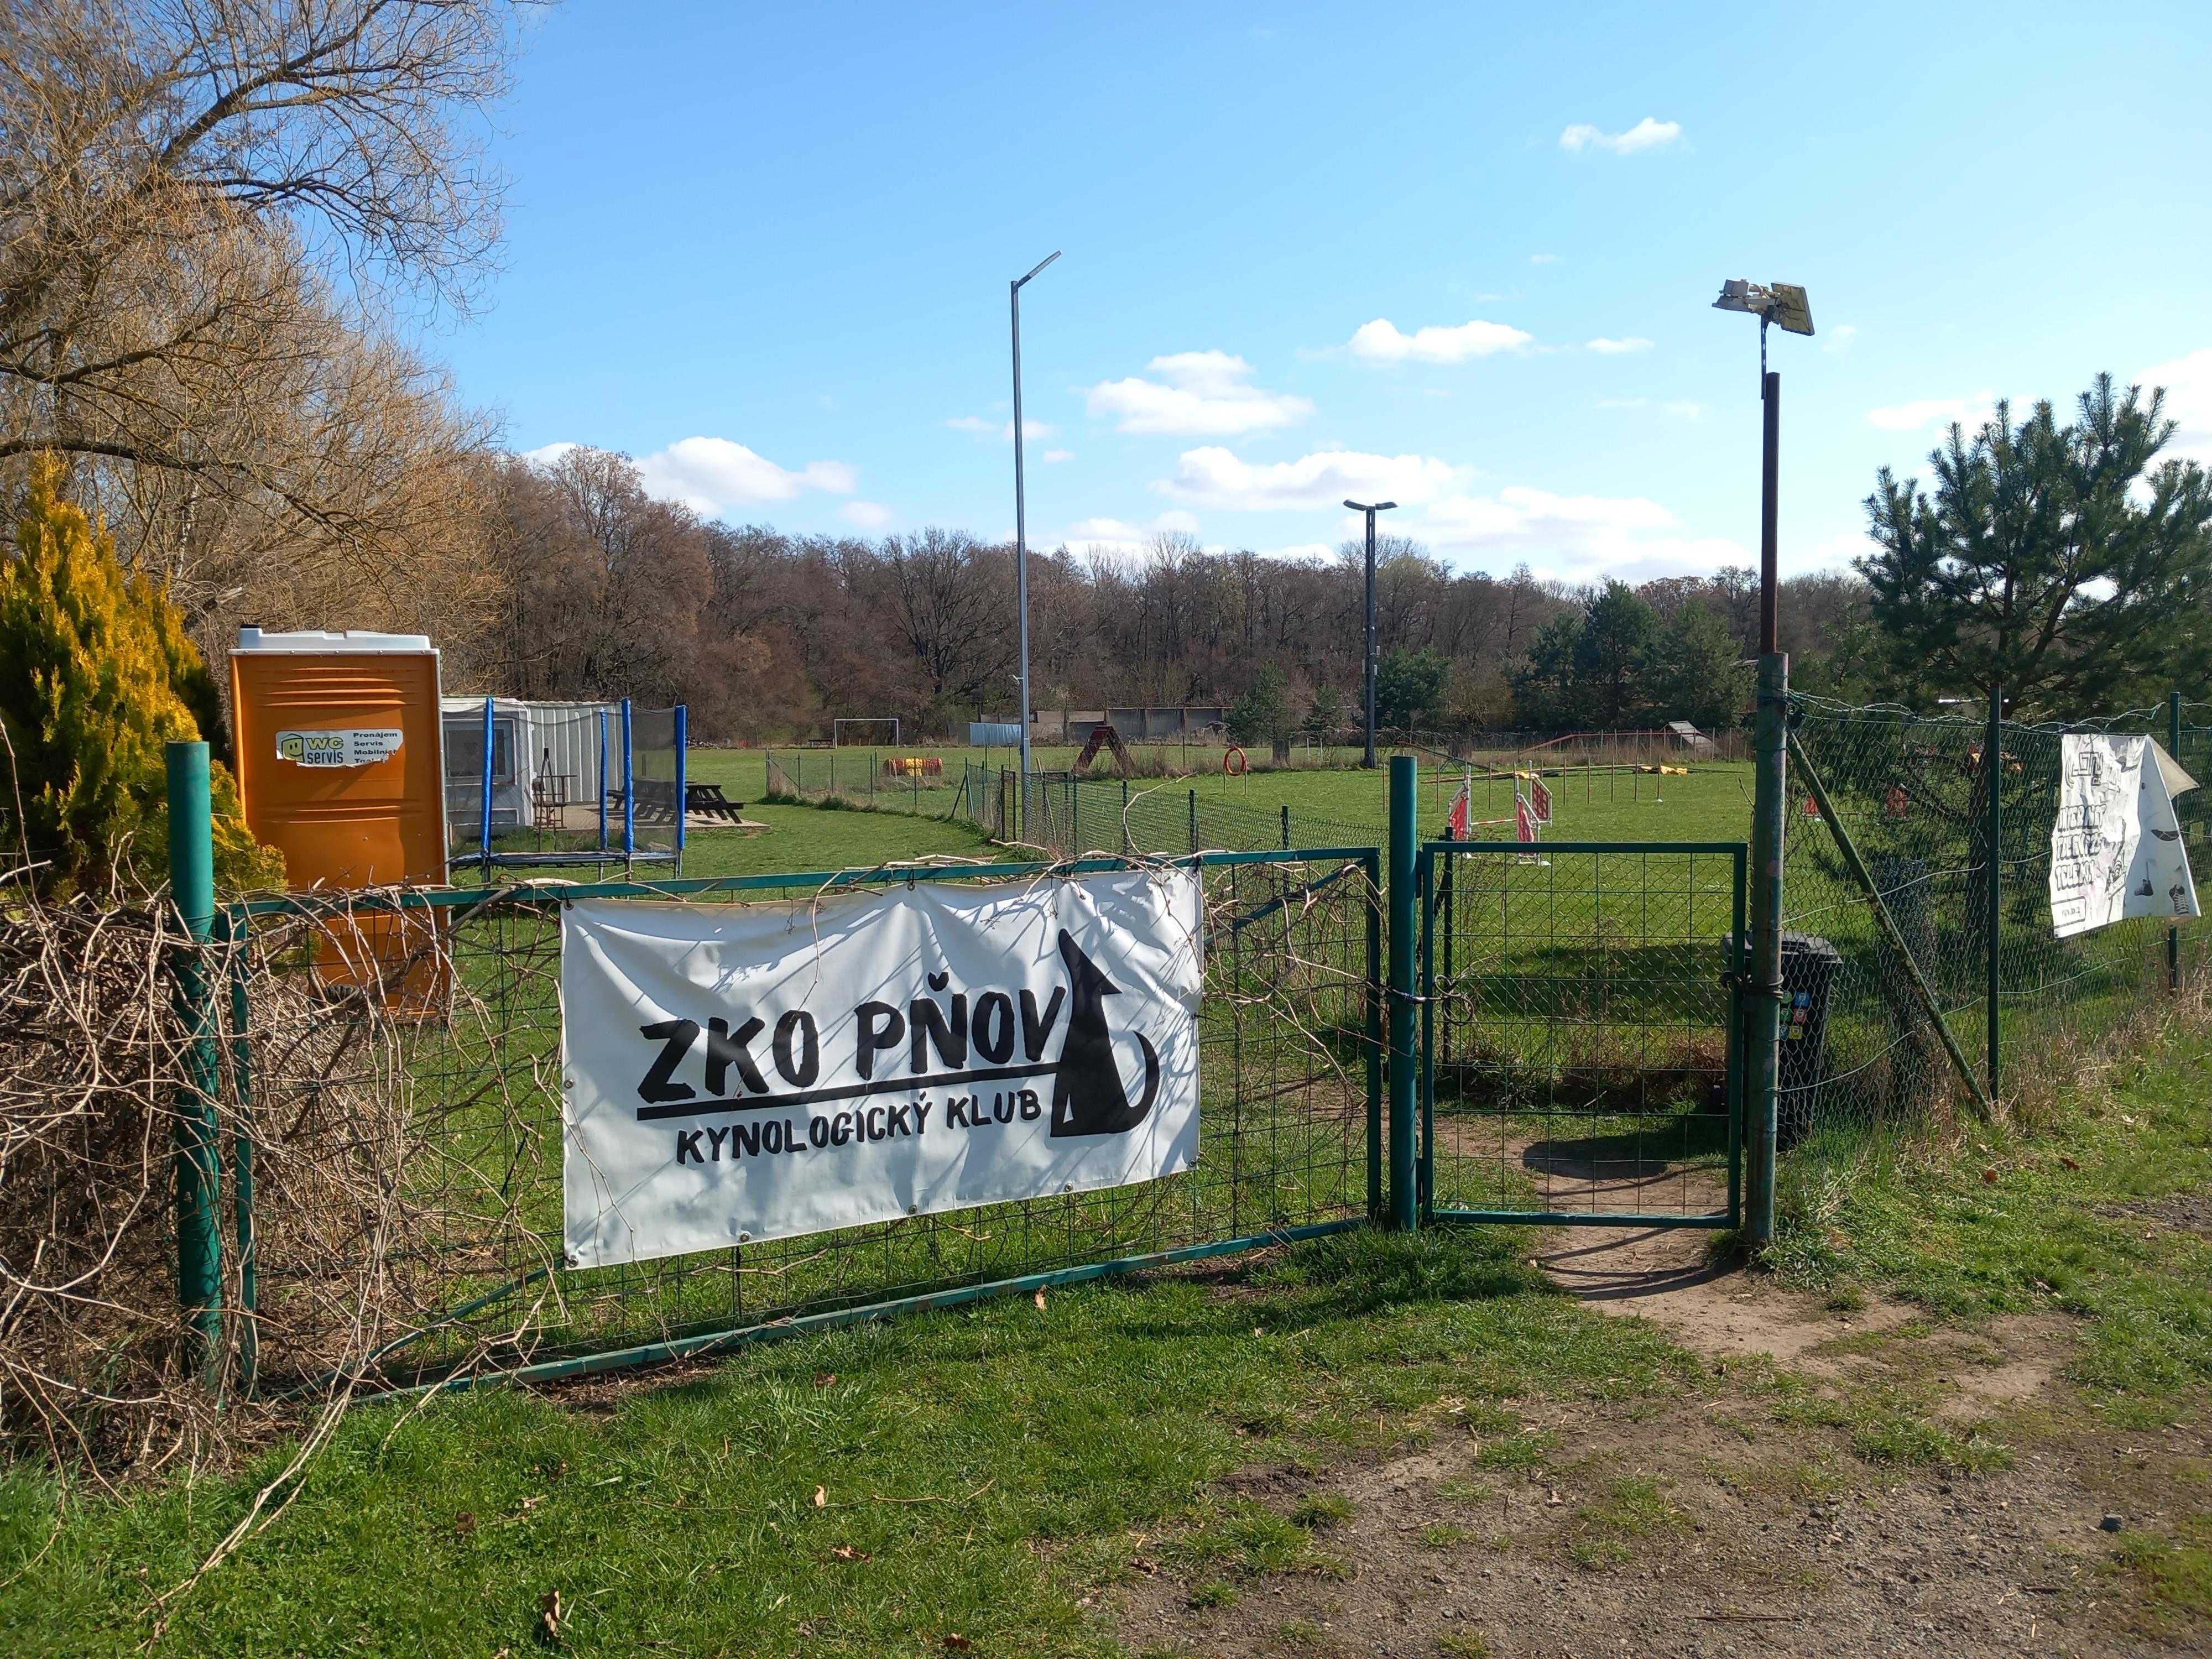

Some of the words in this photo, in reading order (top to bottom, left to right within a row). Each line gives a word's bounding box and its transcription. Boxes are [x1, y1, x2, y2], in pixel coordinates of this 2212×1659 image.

[305, 737, 343, 750] WC
[637, 1009, 820, 1103] ZKO
[854, 972, 1066, 1080] PŇOV
[676, 1091, 932, 1164] KYNOLOGICKÝ
[947, 1089, 1041, 1129] KLUB
